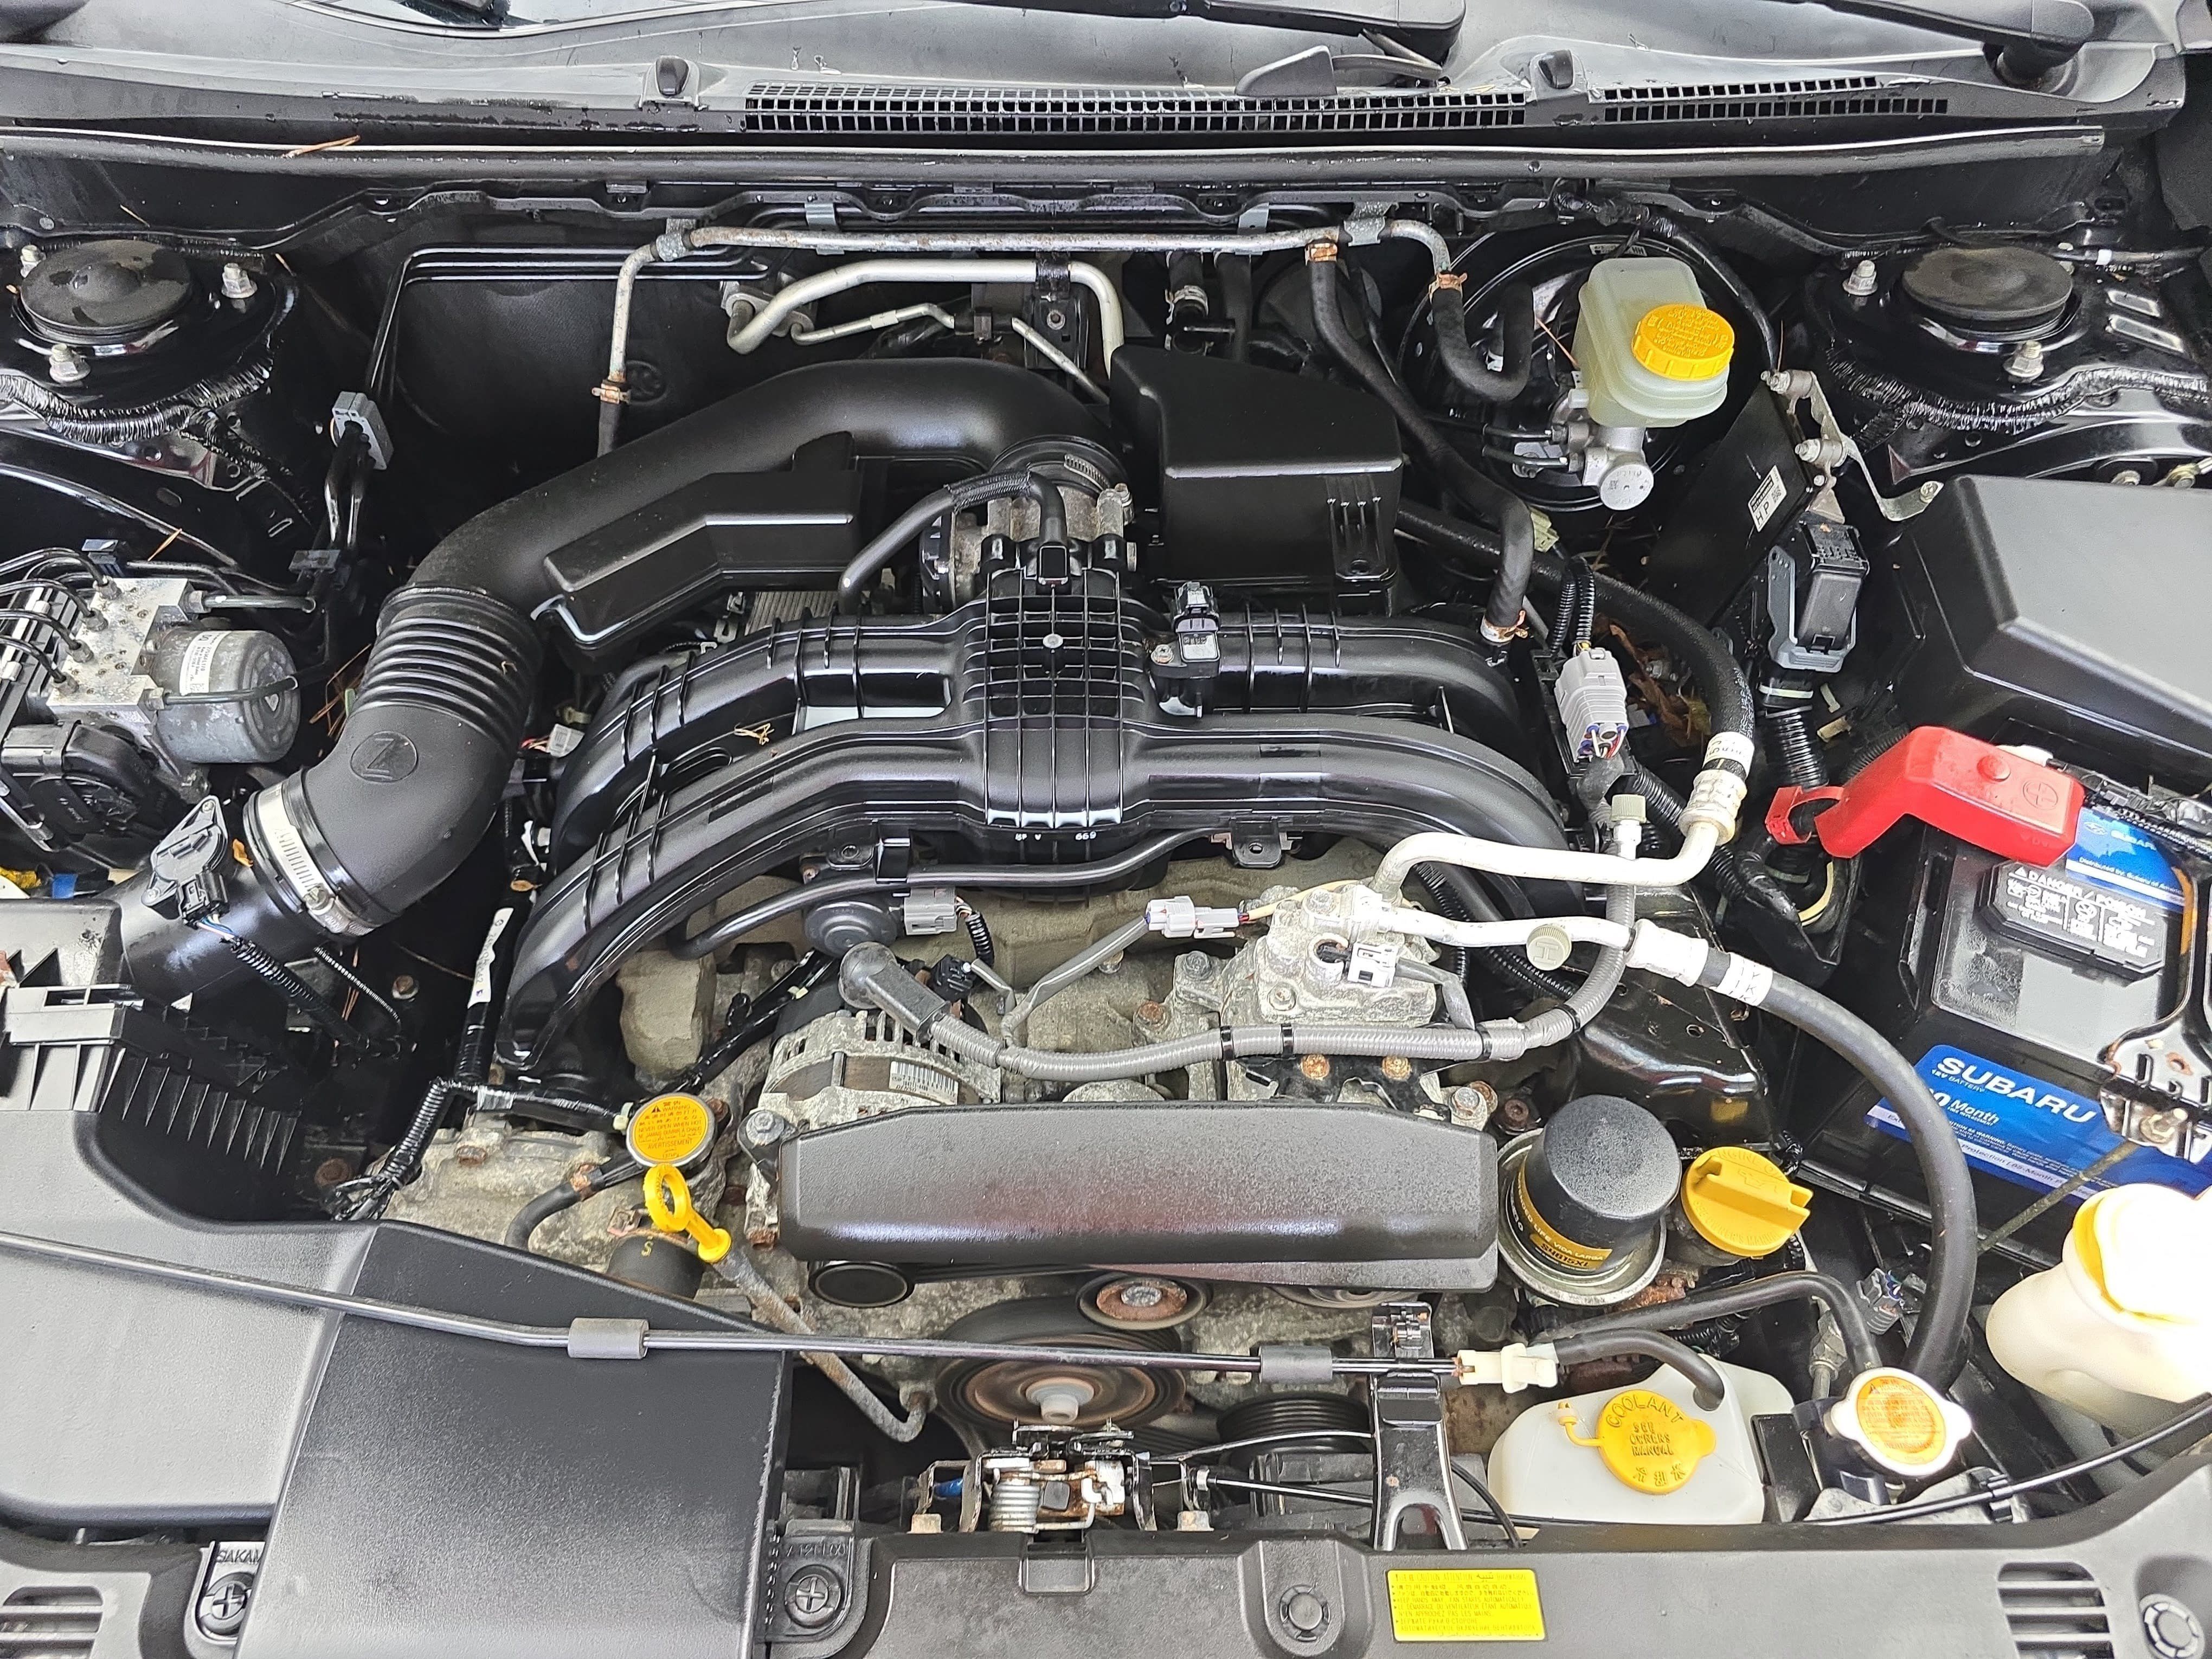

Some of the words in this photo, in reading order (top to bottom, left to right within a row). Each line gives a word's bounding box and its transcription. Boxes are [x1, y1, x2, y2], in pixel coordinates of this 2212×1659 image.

[2111, 829, 2157, 851] SUBAR
[2028, 871, 2082, 897] DANGER
[2095, 895, 2146, 919] POISON
[1937, 1057, 2097, 1123] SUBARU
[1948, 1075, 1985, 1093] BATTERY
[663, 1104, 690, 1112] WARNING
[1951, 1099, 1999, 1124] Month
[647, 1139, 693, 1150] AVERTISSEMENT
[1961, 1143, 2005, 1164] Protection
[1708, 1149, 1760, 1166] ENGINE
[1533, 1223, 1552, 1243] LIFE
[1553, 1242, 1573, 1255] VIDA
[1574, 1252, 1604, 1261] LARGA
[1606, 1394, 1684, 1428] COOLANT
[1633, 1420, 1655, 1433] SEE
[1631, 1445, 1675, 1456] MANUAL
[1443, 1573, 1473, 1581] ATTENTION
